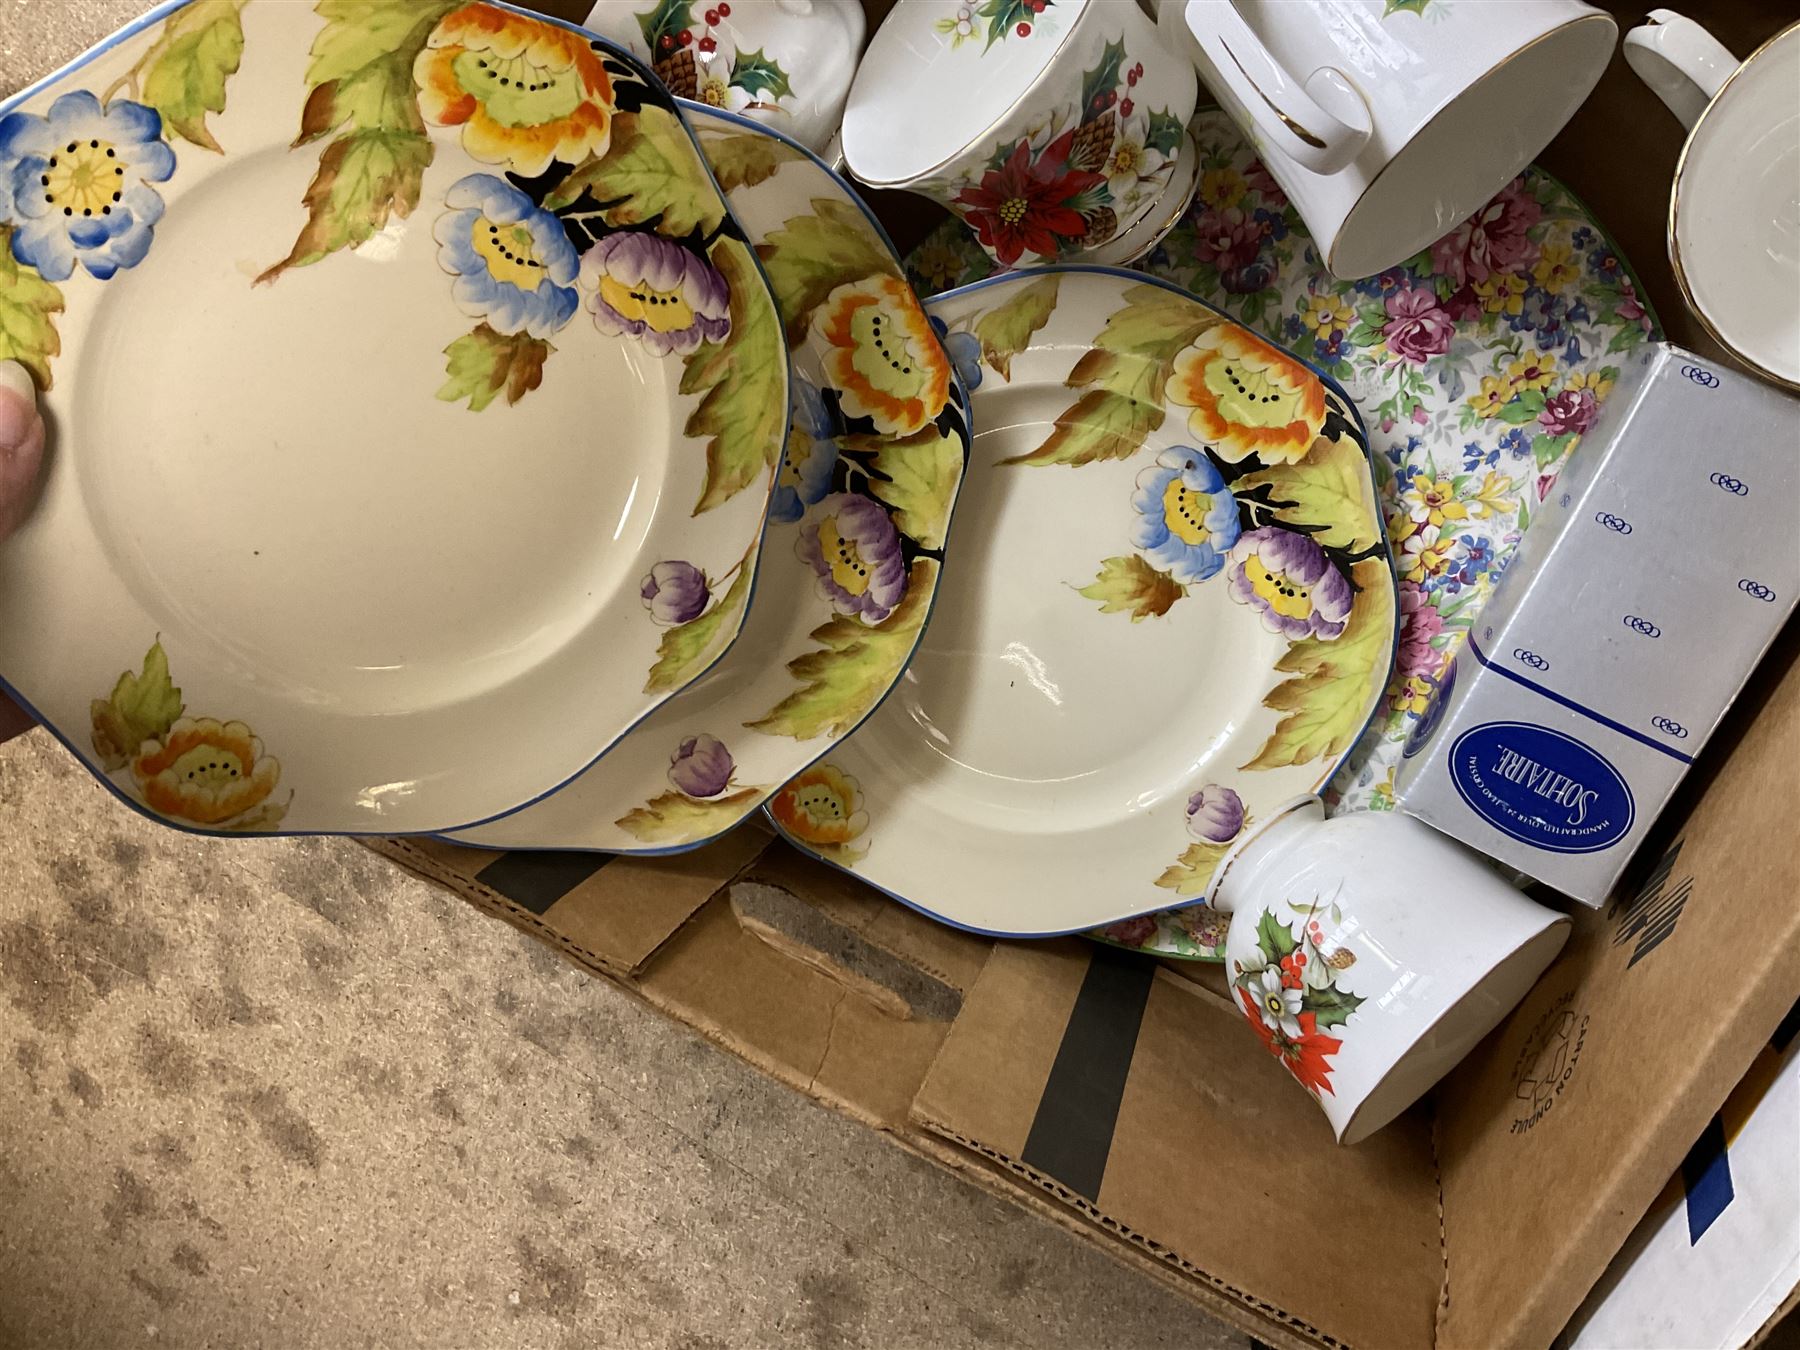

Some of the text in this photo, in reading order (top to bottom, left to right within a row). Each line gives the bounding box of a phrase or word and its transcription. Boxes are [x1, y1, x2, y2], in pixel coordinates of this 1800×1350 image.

[1468, 755, 1486, 789] CRYSTAL
[1492, 748, 1599, 825] SOLITAIRE
[1483, 787, 1502, 807] LEAD
[1518, 814, 1541, 828] OVER
[1555, 1014, 1590, 1096] CARTON
